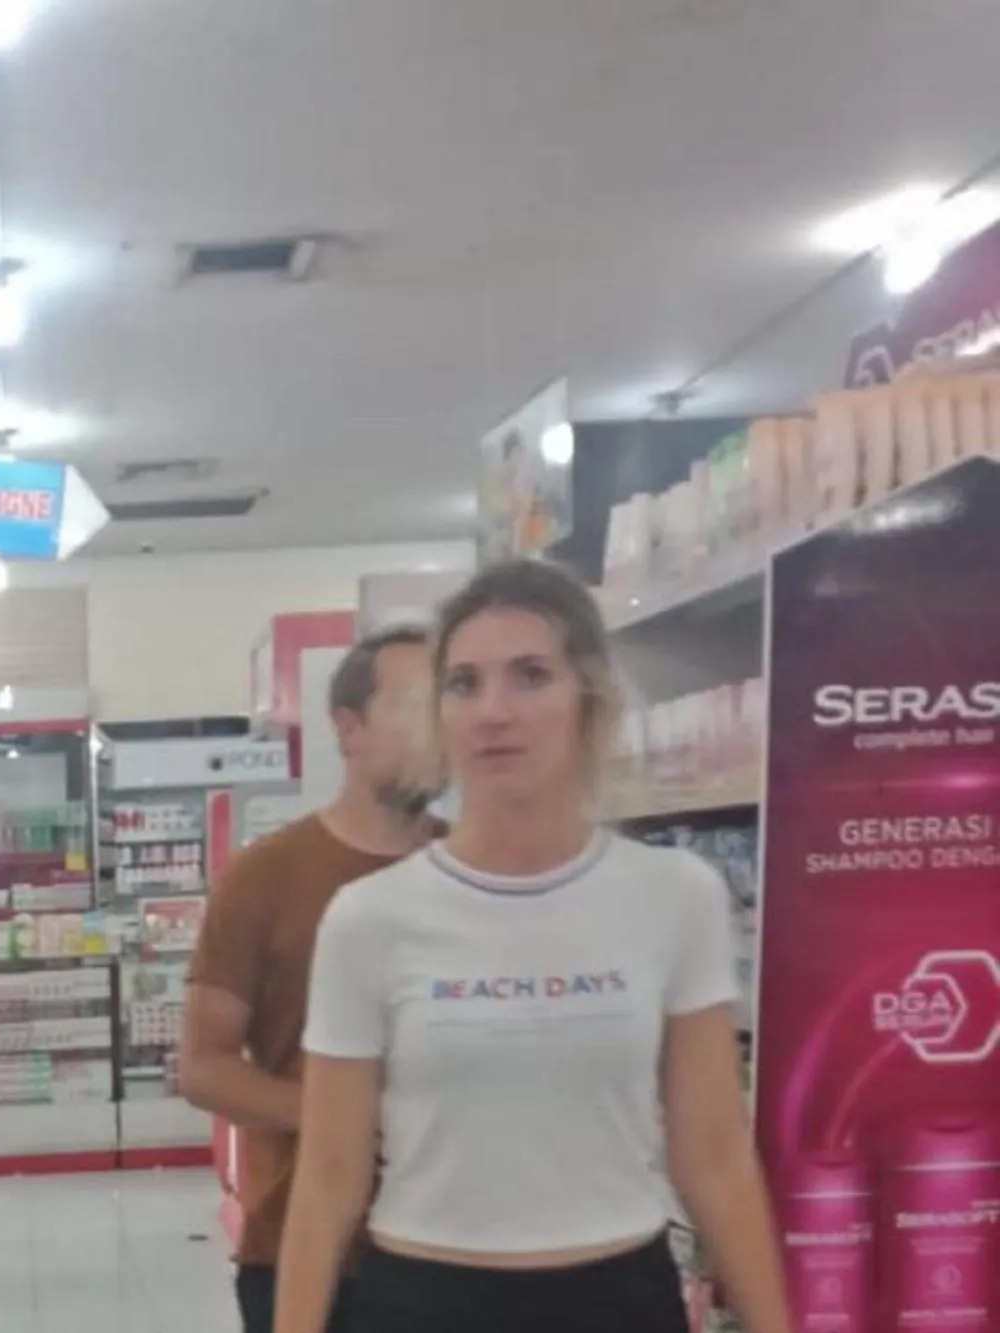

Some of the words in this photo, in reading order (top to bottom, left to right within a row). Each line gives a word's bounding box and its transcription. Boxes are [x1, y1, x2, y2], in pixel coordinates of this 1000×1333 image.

[838, 813, 992, 847] GENERASI
[806, 849, 924, 875] SHAMPOO
[930, 844, 1000, 870] DENG
[432, 978, 536, 999] BEACH
[543, 969, 628, 997] DAYS
